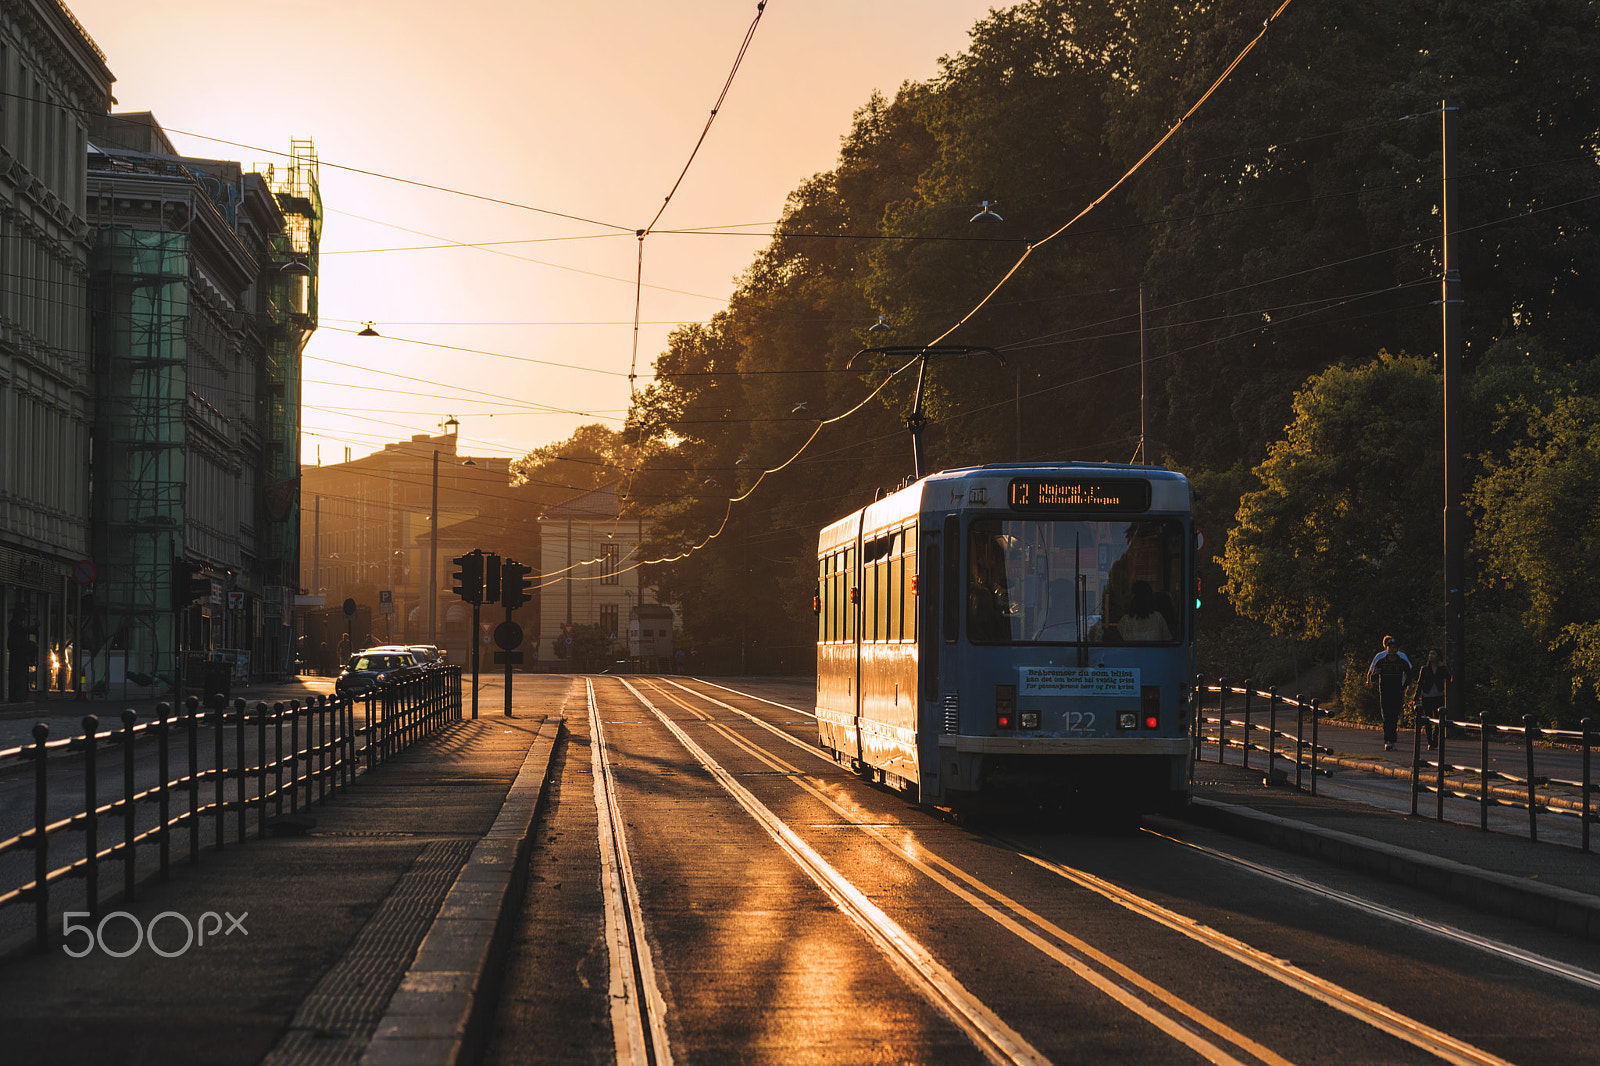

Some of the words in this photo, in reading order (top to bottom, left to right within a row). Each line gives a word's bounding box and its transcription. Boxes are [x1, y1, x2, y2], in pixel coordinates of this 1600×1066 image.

[1012, 483, 1029, 504] 12
[1078, 669, 1090, 677] du
[1062, 711, 1096, 732] 122
